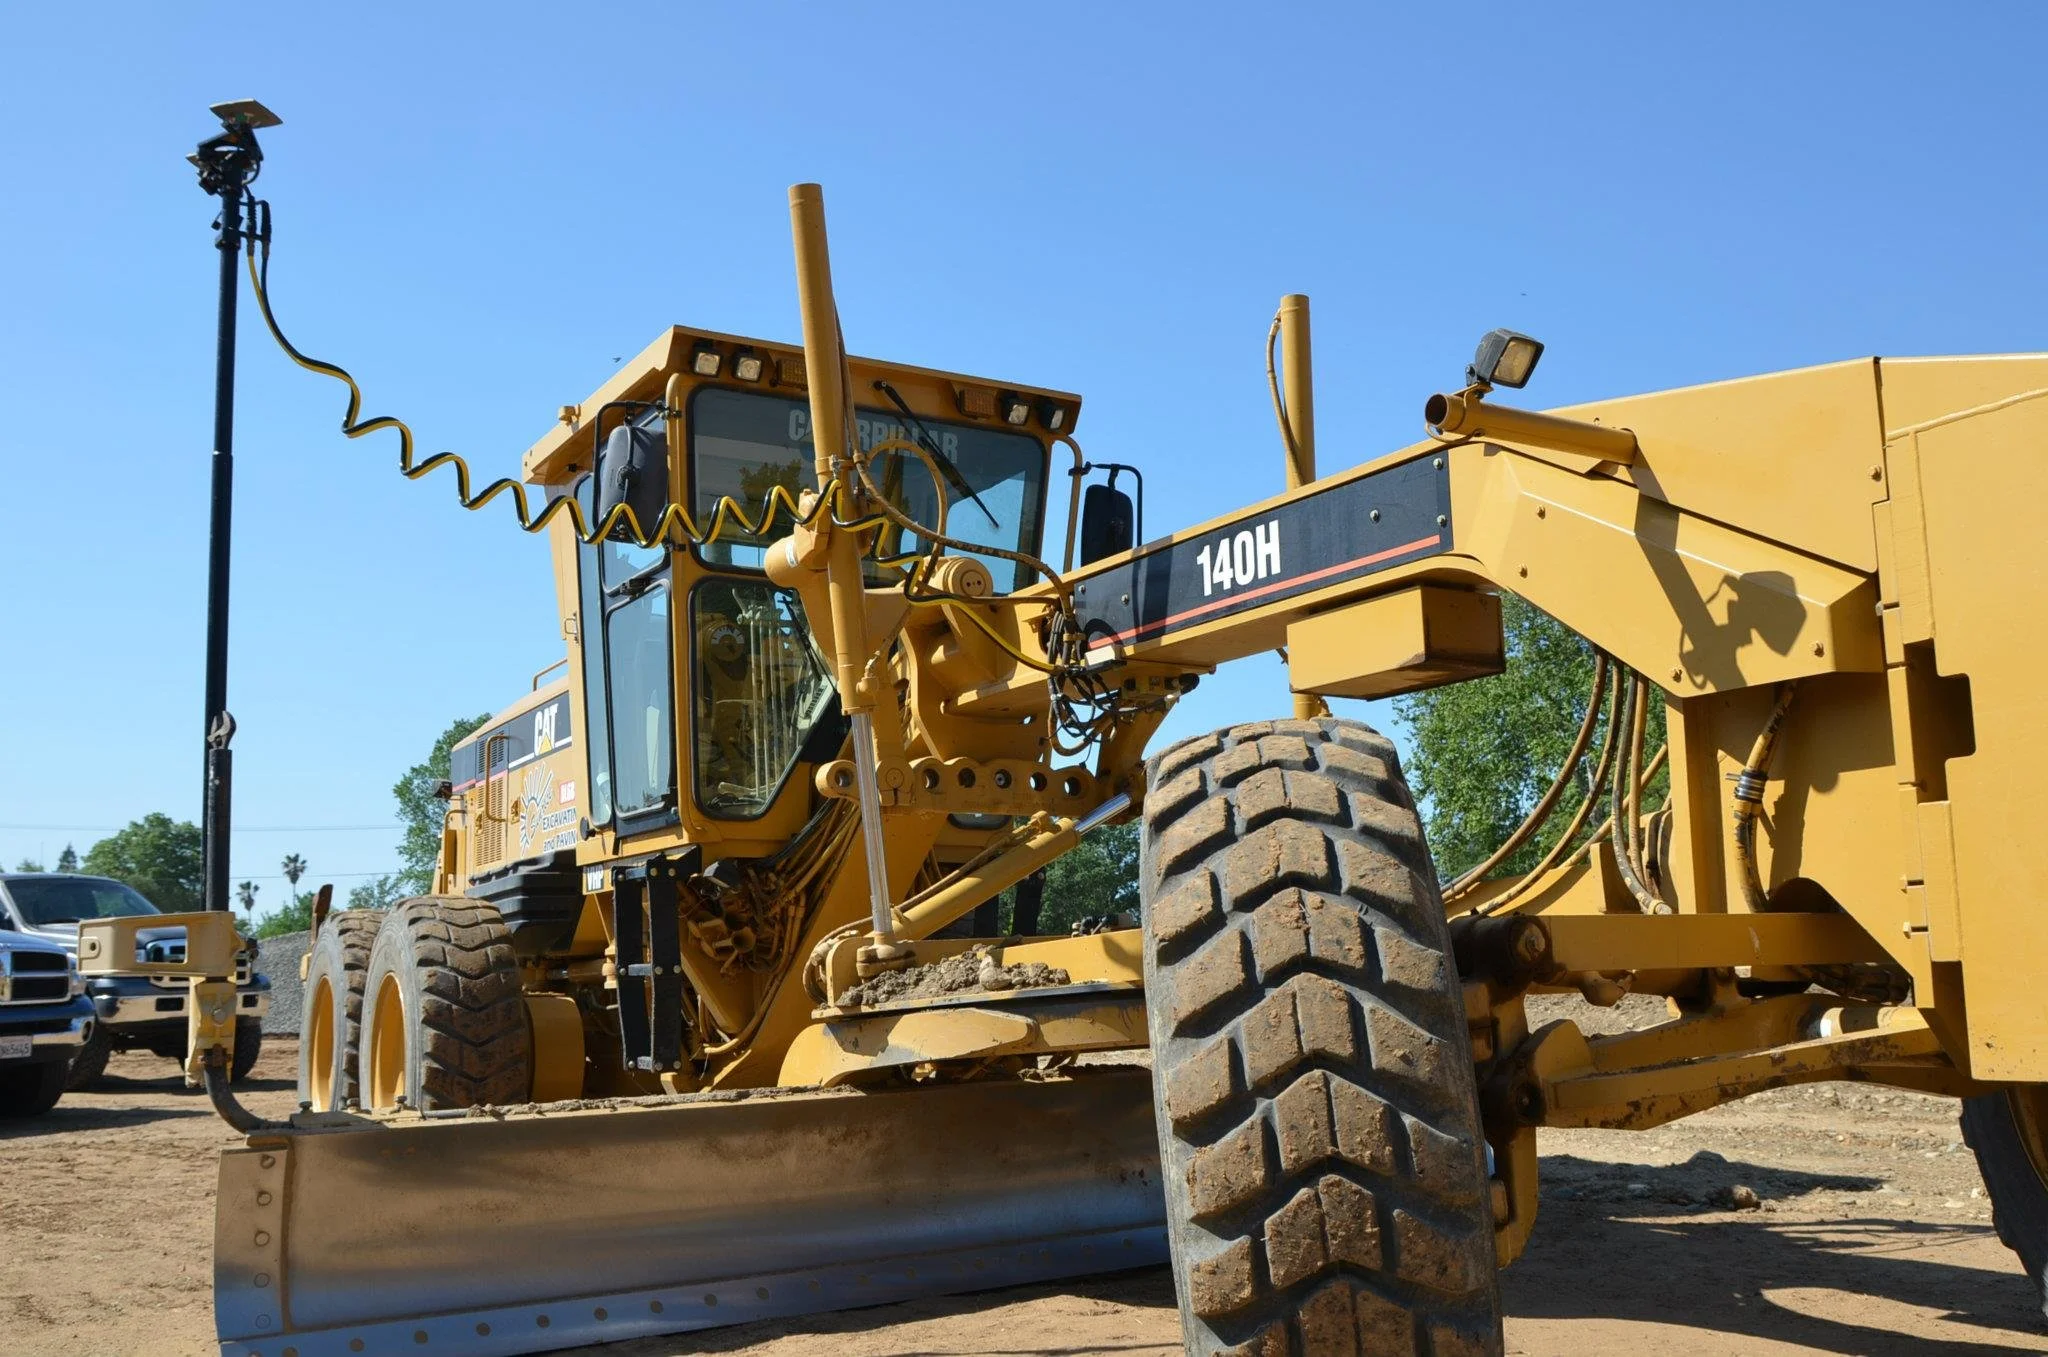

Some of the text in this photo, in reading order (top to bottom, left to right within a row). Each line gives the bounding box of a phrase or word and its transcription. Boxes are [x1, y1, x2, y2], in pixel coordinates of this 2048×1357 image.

[788, 409, 958, 464] CRPILLAR
[1196, 519, 1281, 597] 140H
[534, 703, 559, 756] CAT
[587, 864, 604, 891] VHP
